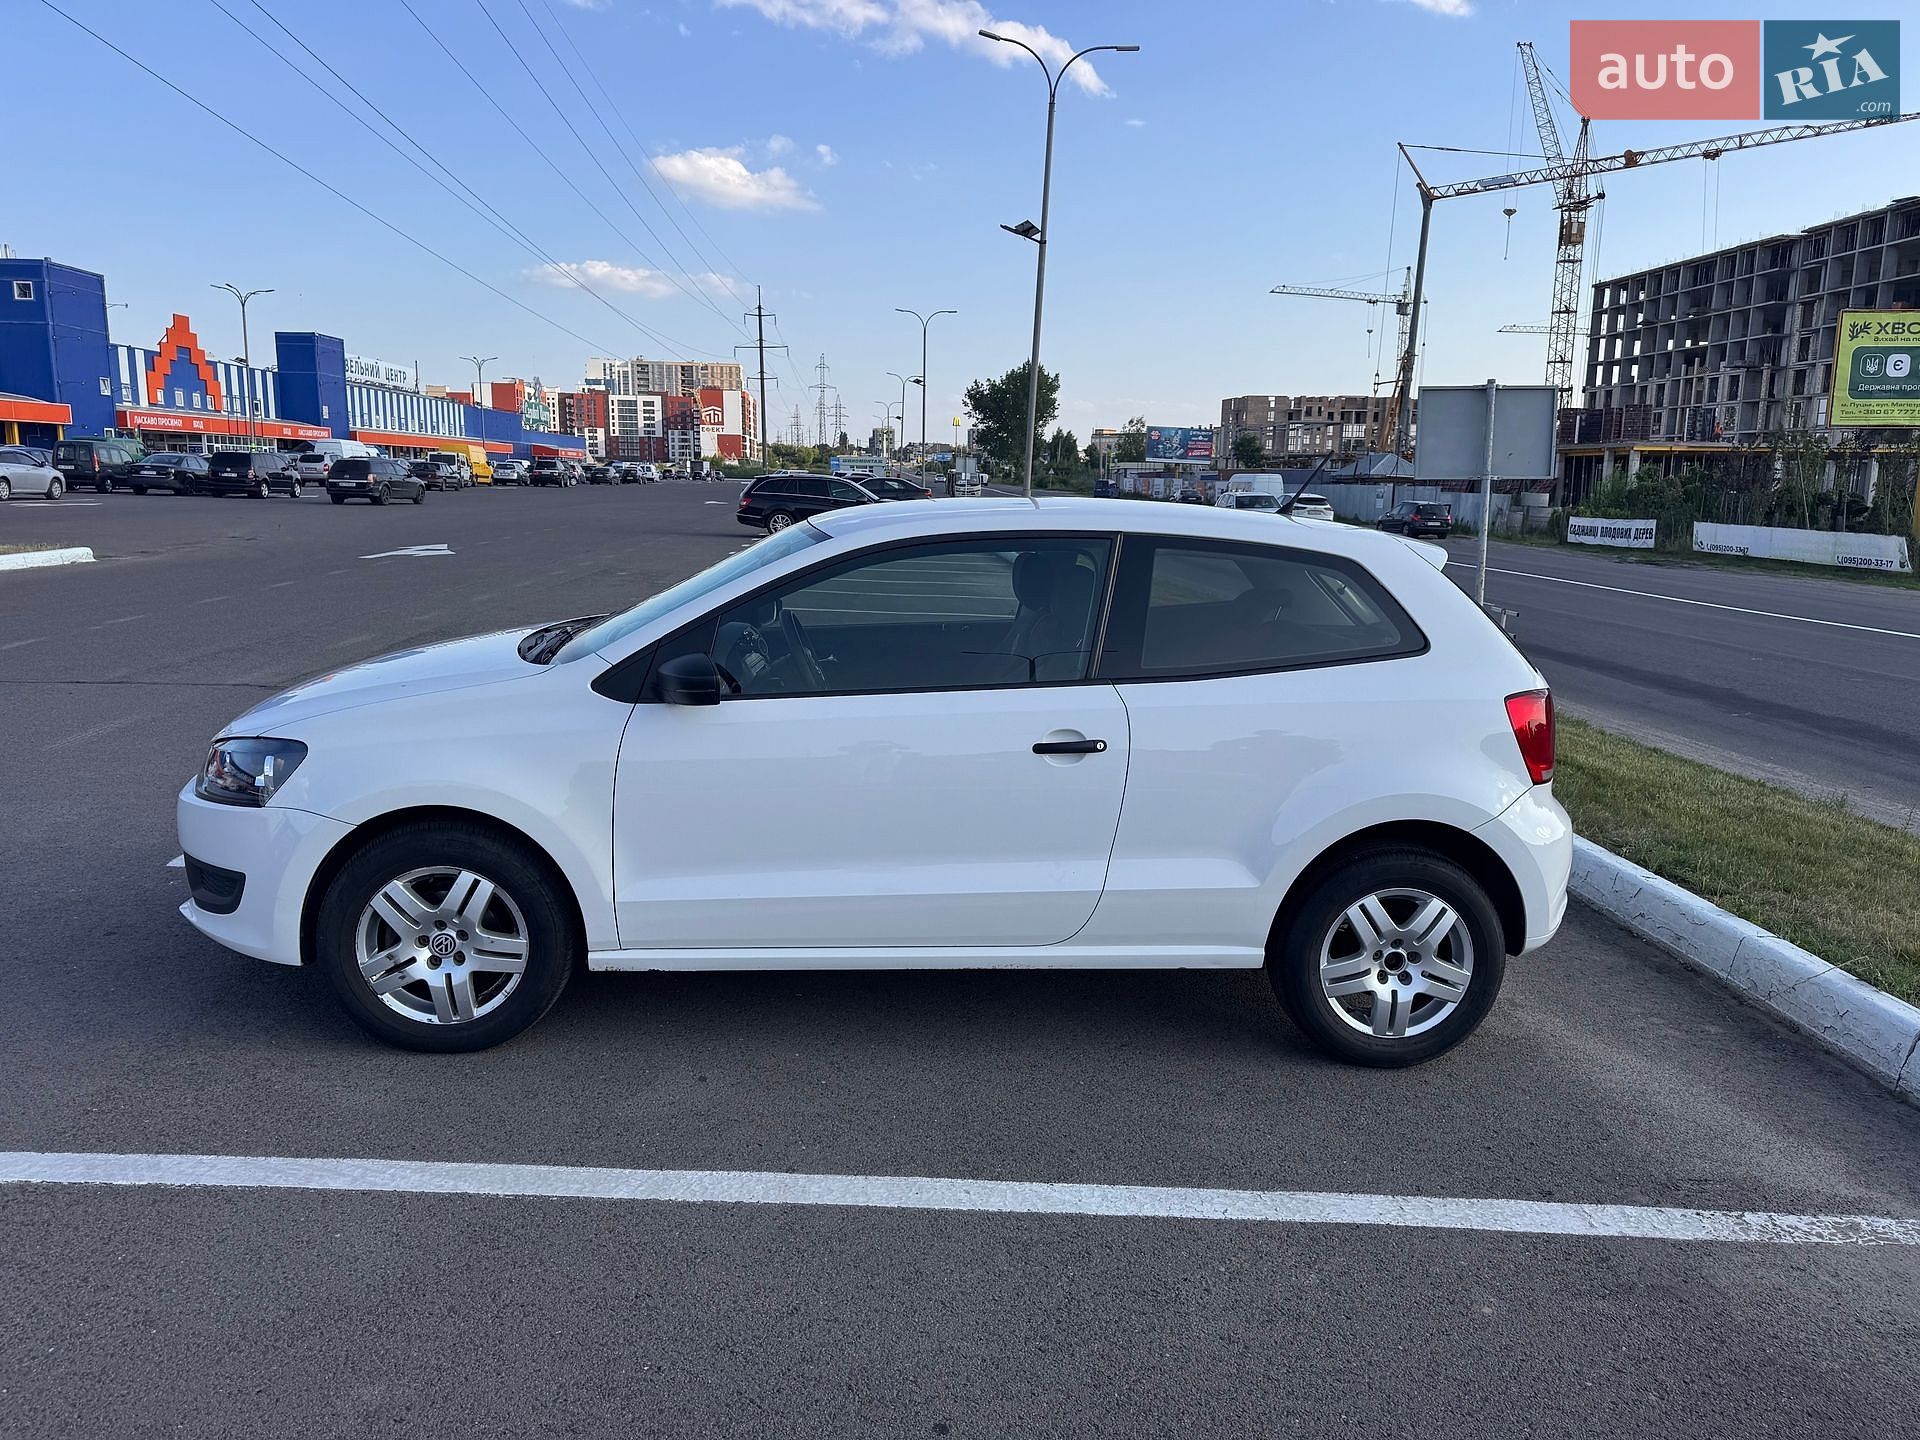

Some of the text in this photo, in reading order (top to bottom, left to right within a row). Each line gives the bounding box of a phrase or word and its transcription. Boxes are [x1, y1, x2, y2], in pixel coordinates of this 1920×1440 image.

[384, 366, 407, 383] ЦЕНТР
[1857, 383, 1900, 392] Державна
[134, 415, 157, 425] ЛАСКАВО
[1633, 527, 1654, 541] ДЕРЕВ
[1841, 556, 1893, 568] (095)200-33-17
